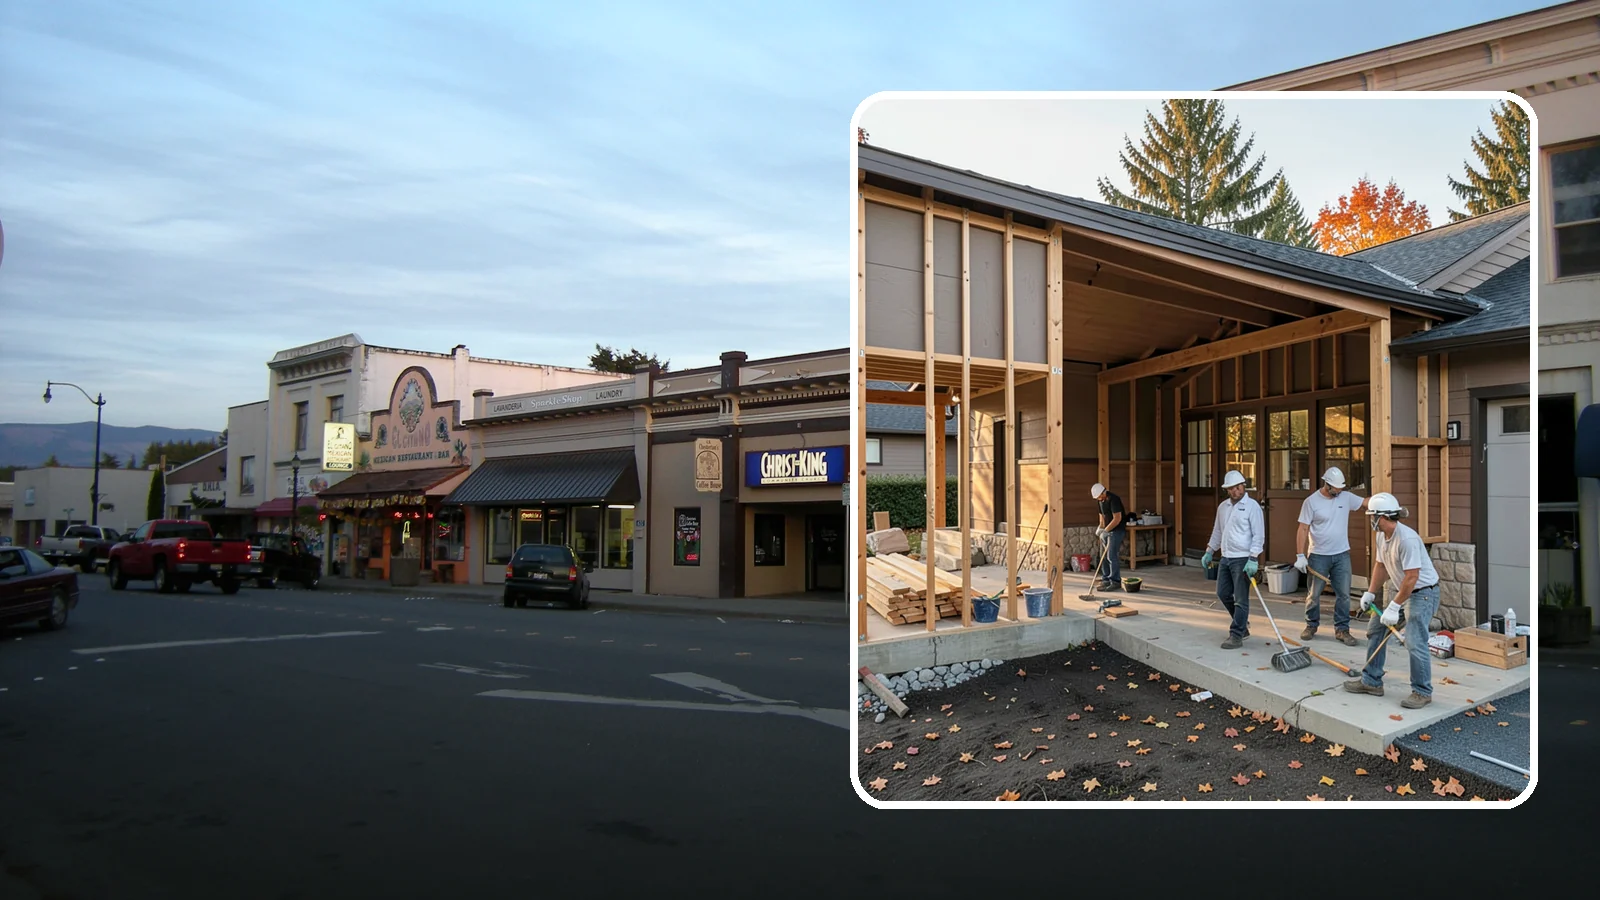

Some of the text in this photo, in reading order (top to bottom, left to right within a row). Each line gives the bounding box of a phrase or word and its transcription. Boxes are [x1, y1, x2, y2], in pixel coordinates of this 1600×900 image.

[493, 389, 623, 413] LAVANDERIA Sparkle Shop LAUNDRY
[373, 454, 396, 464] MEXICAN
[397, 451, 433, 462] RESTAURANT
[437, 450, 450, 459] BAR
[761, 449, 828, 478] CHRIST KING
